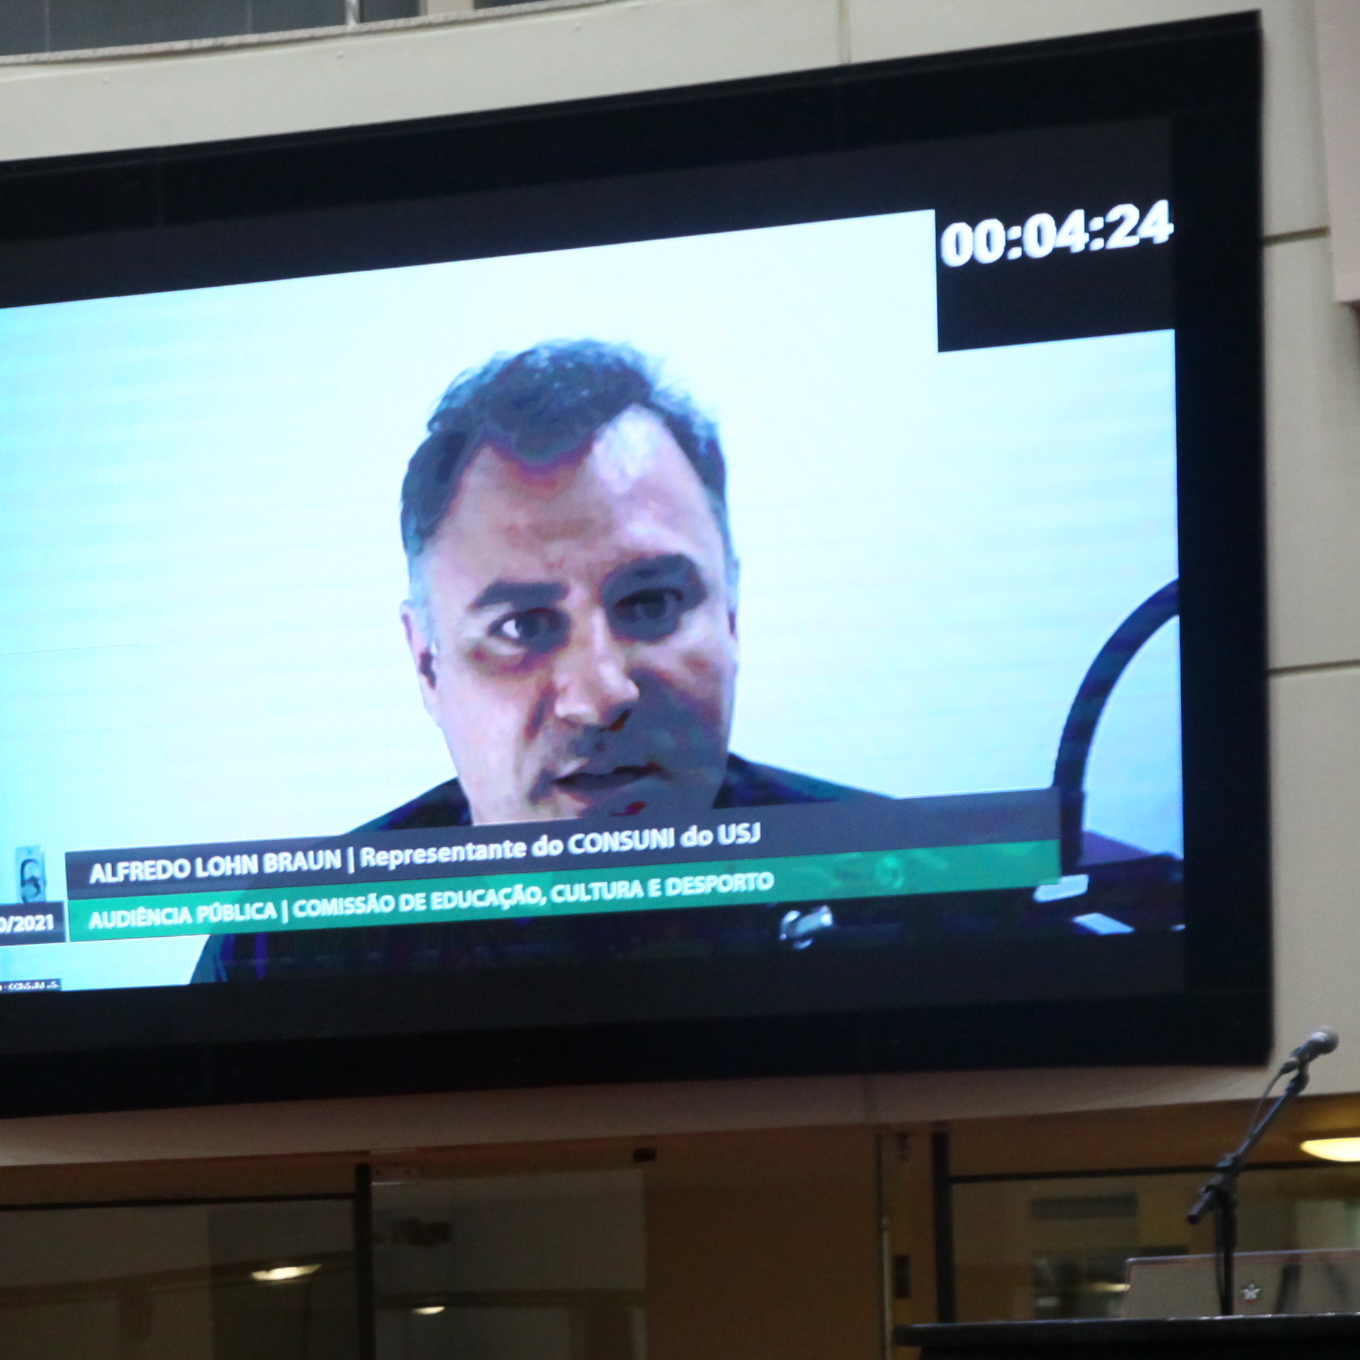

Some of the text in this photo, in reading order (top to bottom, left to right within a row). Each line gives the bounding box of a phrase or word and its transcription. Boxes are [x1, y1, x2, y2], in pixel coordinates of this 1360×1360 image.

[941, 199, 1174, 267] 00:04:24
[89, 858, 191, 884] ALFREDO
[195, 854, 258, 878] LOHN
[263, 849, 342, 873] BRAUN
[360, 840, 527, 870] Representante
[532, 834, 564, 857] do
[568, 827, 675, 855] CONSUNI
[680, 825, 713, 847] do
[717, 822, 761, 845] USJ
[89, 906, 193, 929] AUDIÊNCIA
[197, 901, 278, 923] PÚBLICA
[292, 892, 395, 917] COMISSÃO
[399, 892, 427, 912] DE
[431, 884, 547, 910] EDUCAÇÃO,
[550, 880, 644, 903] CULTURA
[648, 878, 662, 898] E
[665, 871, 775, 897] DESPORTO
